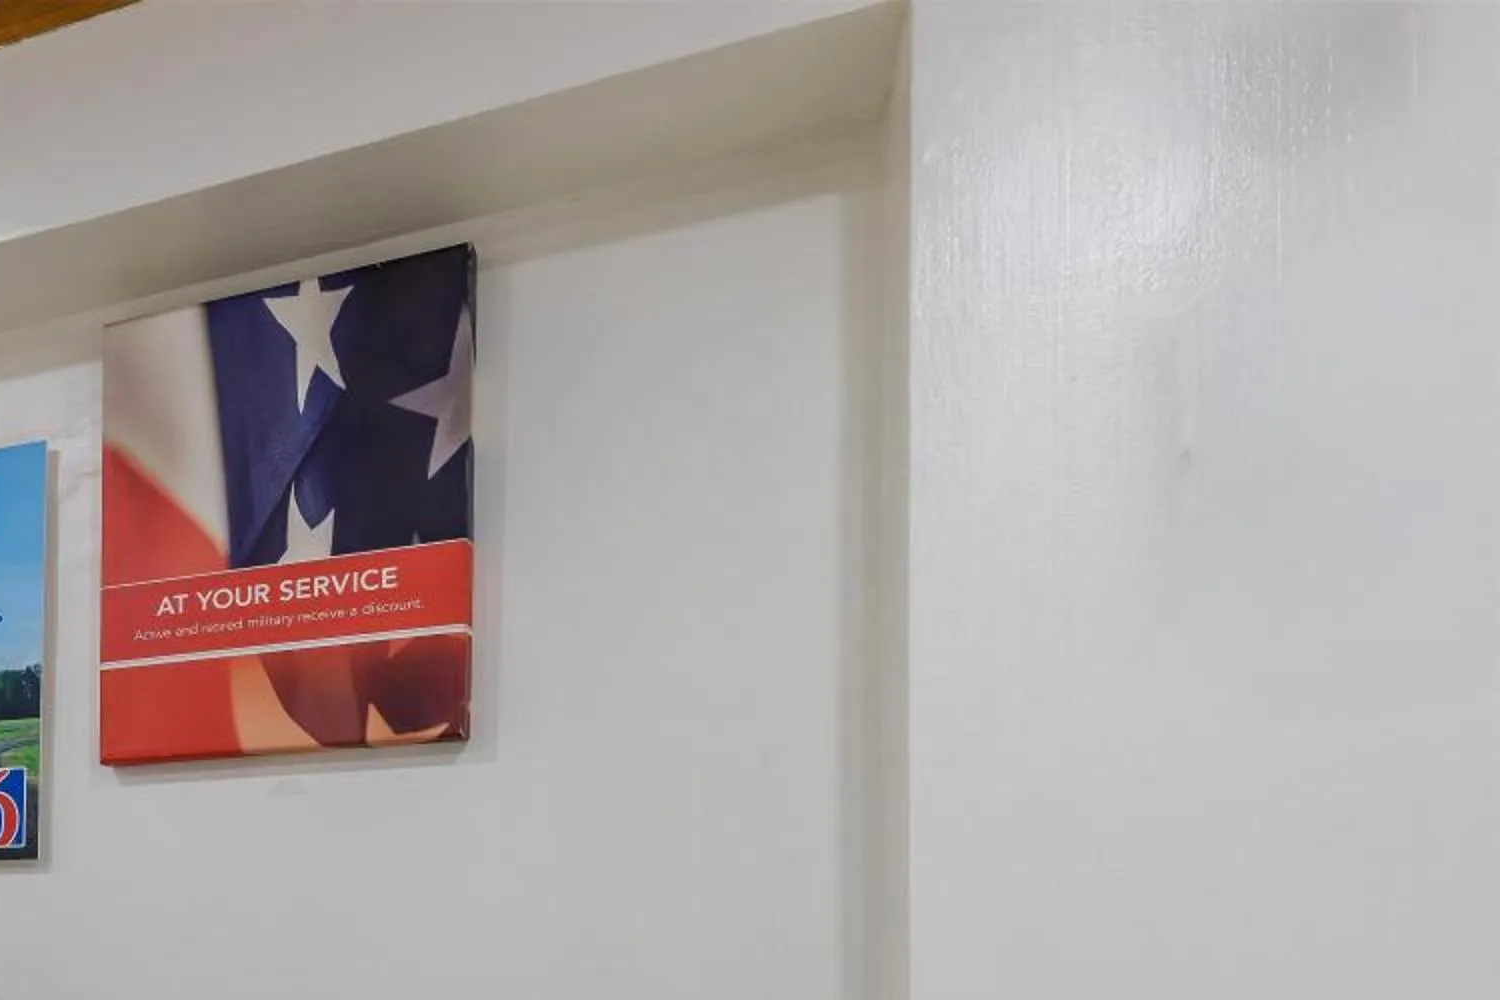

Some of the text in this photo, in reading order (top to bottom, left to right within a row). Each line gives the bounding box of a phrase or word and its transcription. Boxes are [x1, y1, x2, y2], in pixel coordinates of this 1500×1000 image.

[155, 567, 399, 616] AT YOUR SERVICE
[175, 623, 199, 637] and
[247, 613, 294, 628] military
[297, 606, 345, 622] receive
[349, 607, 359, 617] a
